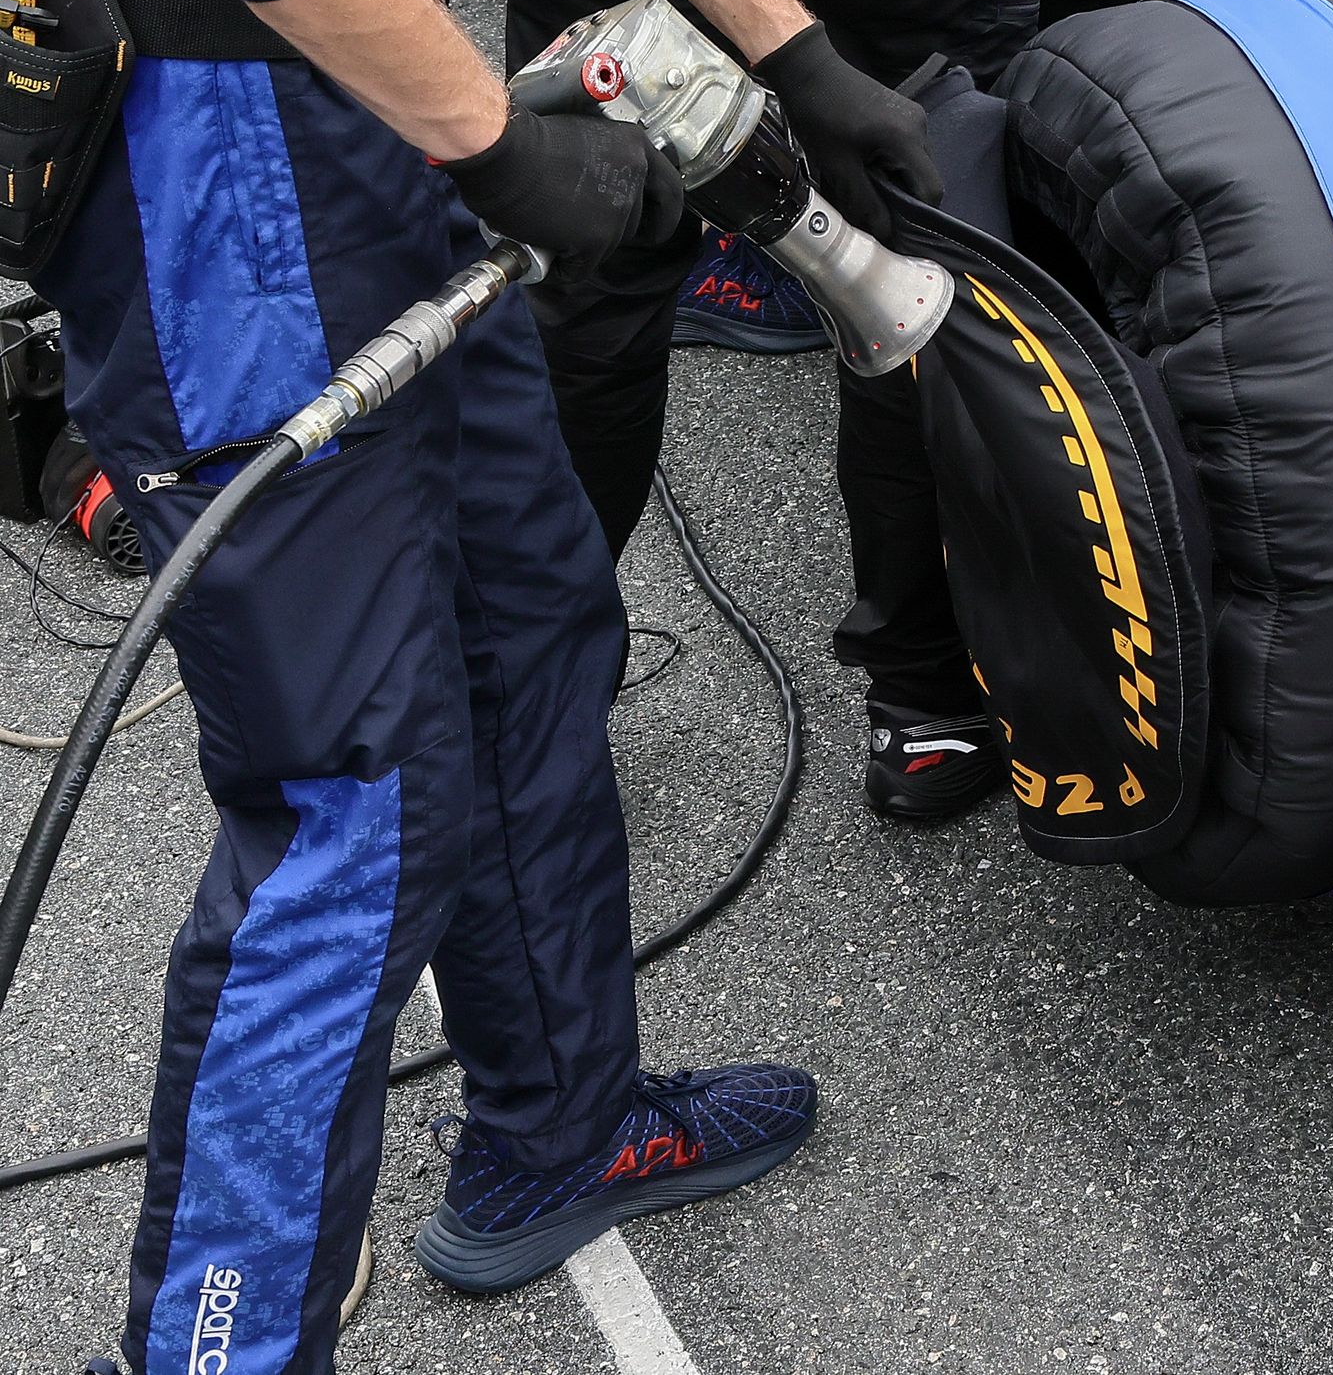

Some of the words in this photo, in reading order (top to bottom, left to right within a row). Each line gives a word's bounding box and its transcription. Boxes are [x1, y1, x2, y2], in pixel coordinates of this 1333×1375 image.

[7, 70, 51, 94] Kuny's
[601, 1128, 704, 1183] APL
[188, 1263, 243, 1375] sparc
